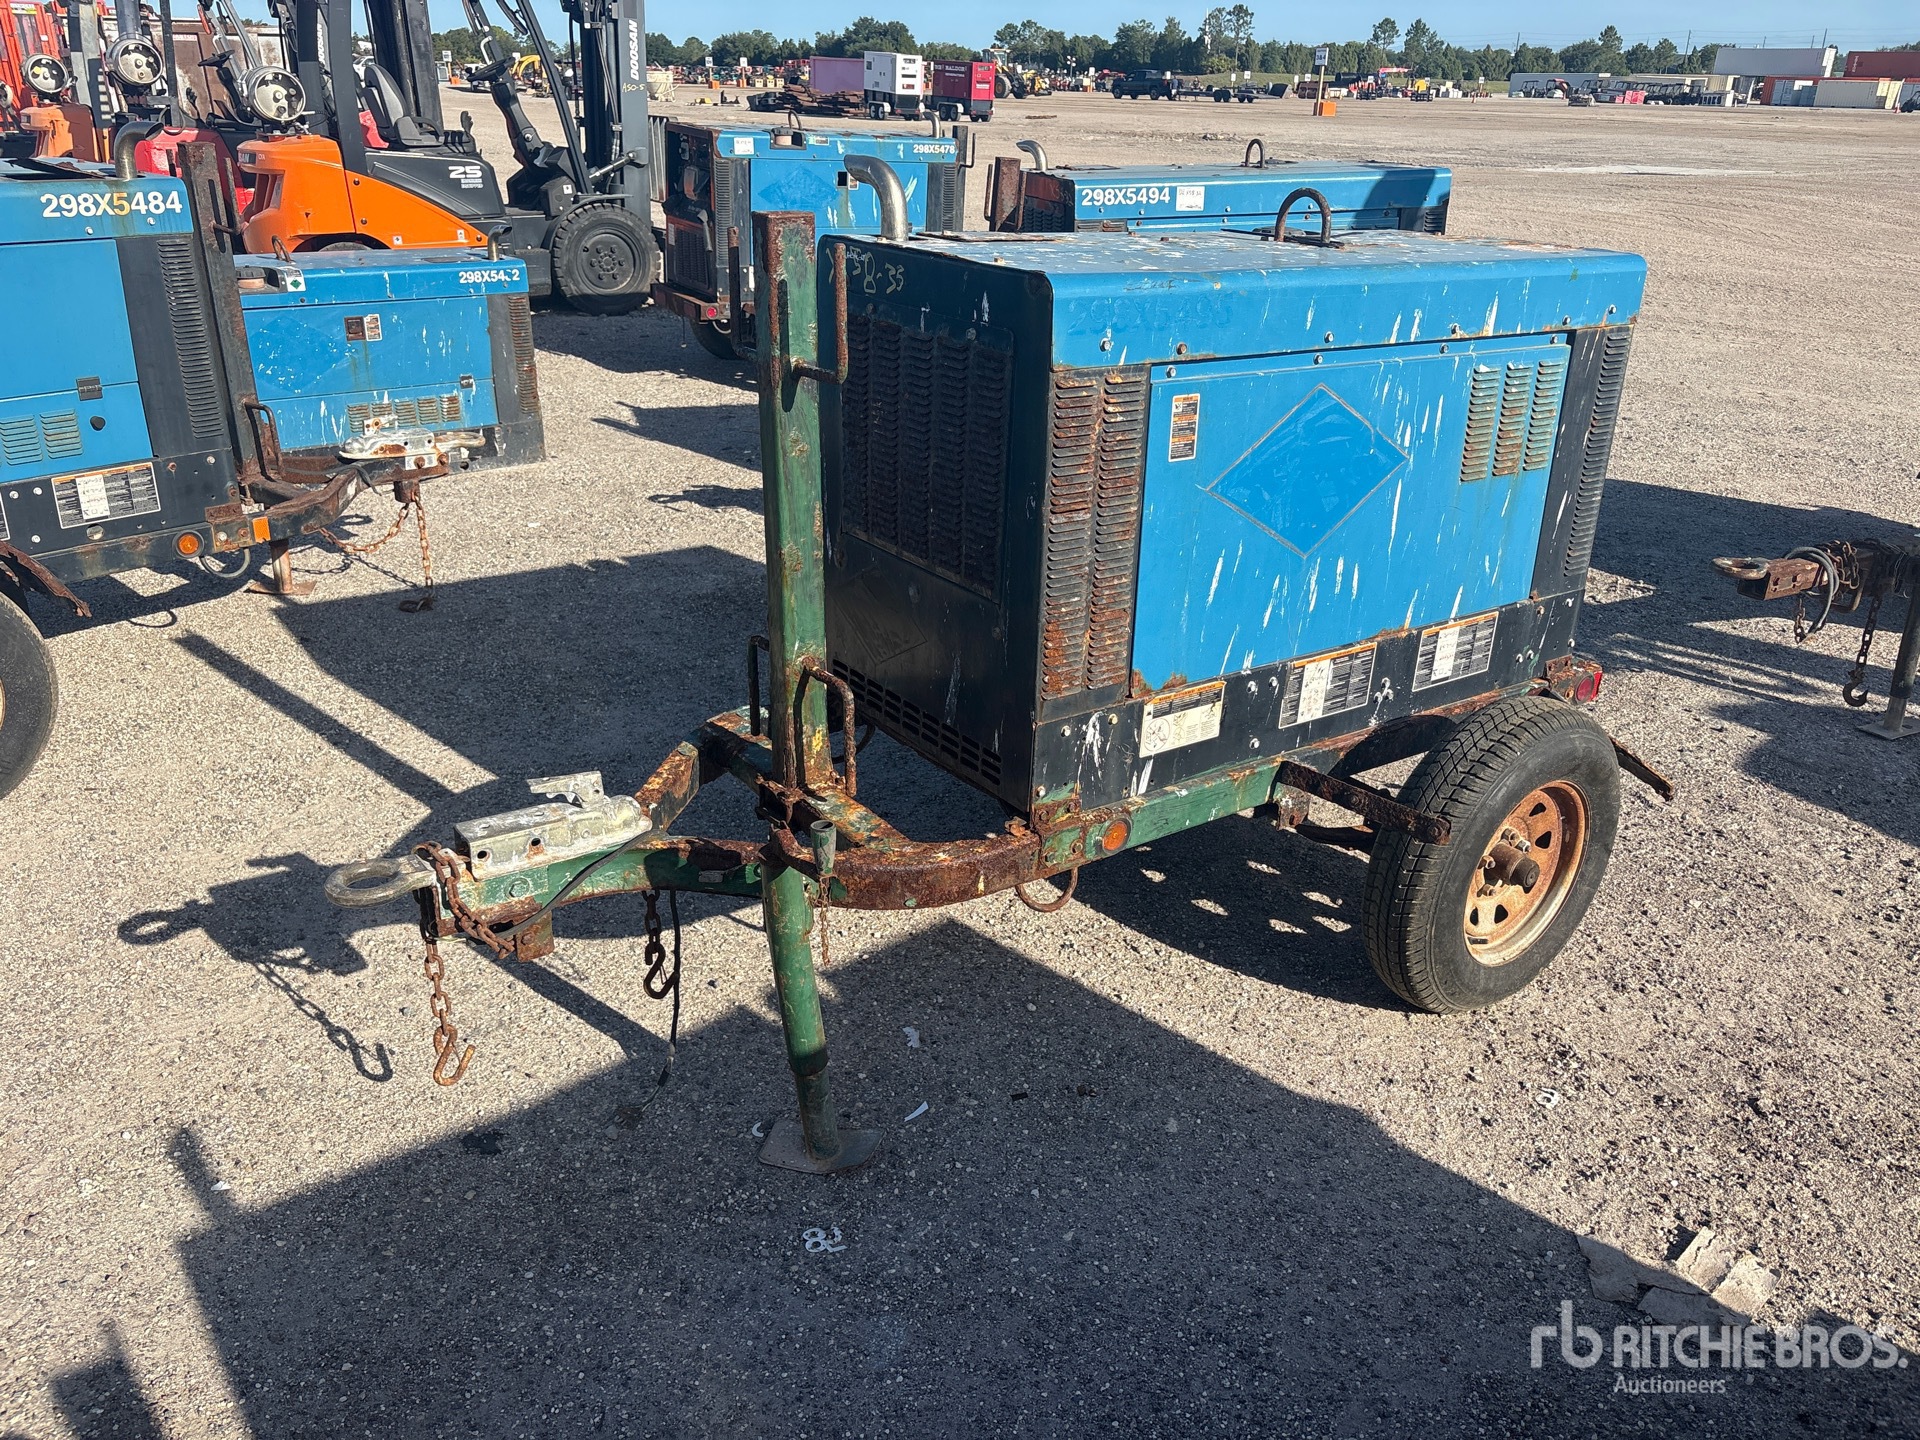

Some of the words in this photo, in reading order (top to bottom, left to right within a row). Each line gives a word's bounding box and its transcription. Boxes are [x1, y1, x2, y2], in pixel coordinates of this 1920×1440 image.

[628, 19, 640, 80] DOOSAN
[912, 143, 956, 154] 298X5478
[448, 165, 483, 179] 25
[40, 190, 183, 218] 298X5484
[1081, 187, 1171, 206] 298X5494
